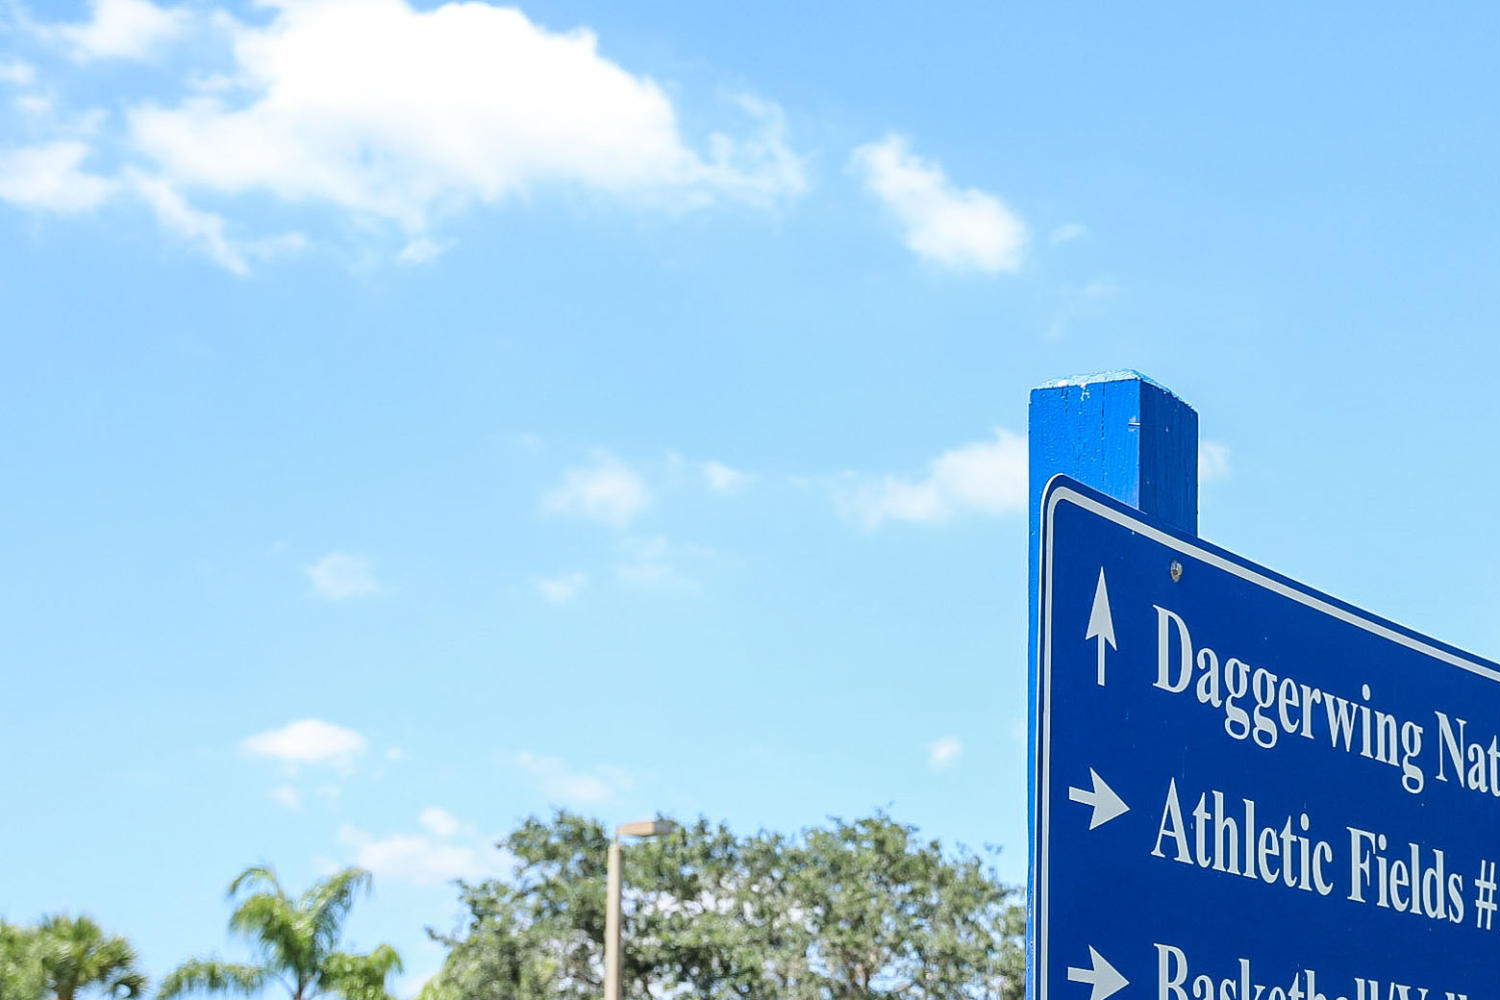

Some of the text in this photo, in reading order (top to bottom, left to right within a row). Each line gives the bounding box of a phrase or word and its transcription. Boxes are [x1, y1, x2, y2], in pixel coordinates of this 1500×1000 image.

[1153, 605, 1423, 793] Daggerwing
[1151, 778, 1333, 895] Athletic
[1347, 827, 1463, 923] Fields
